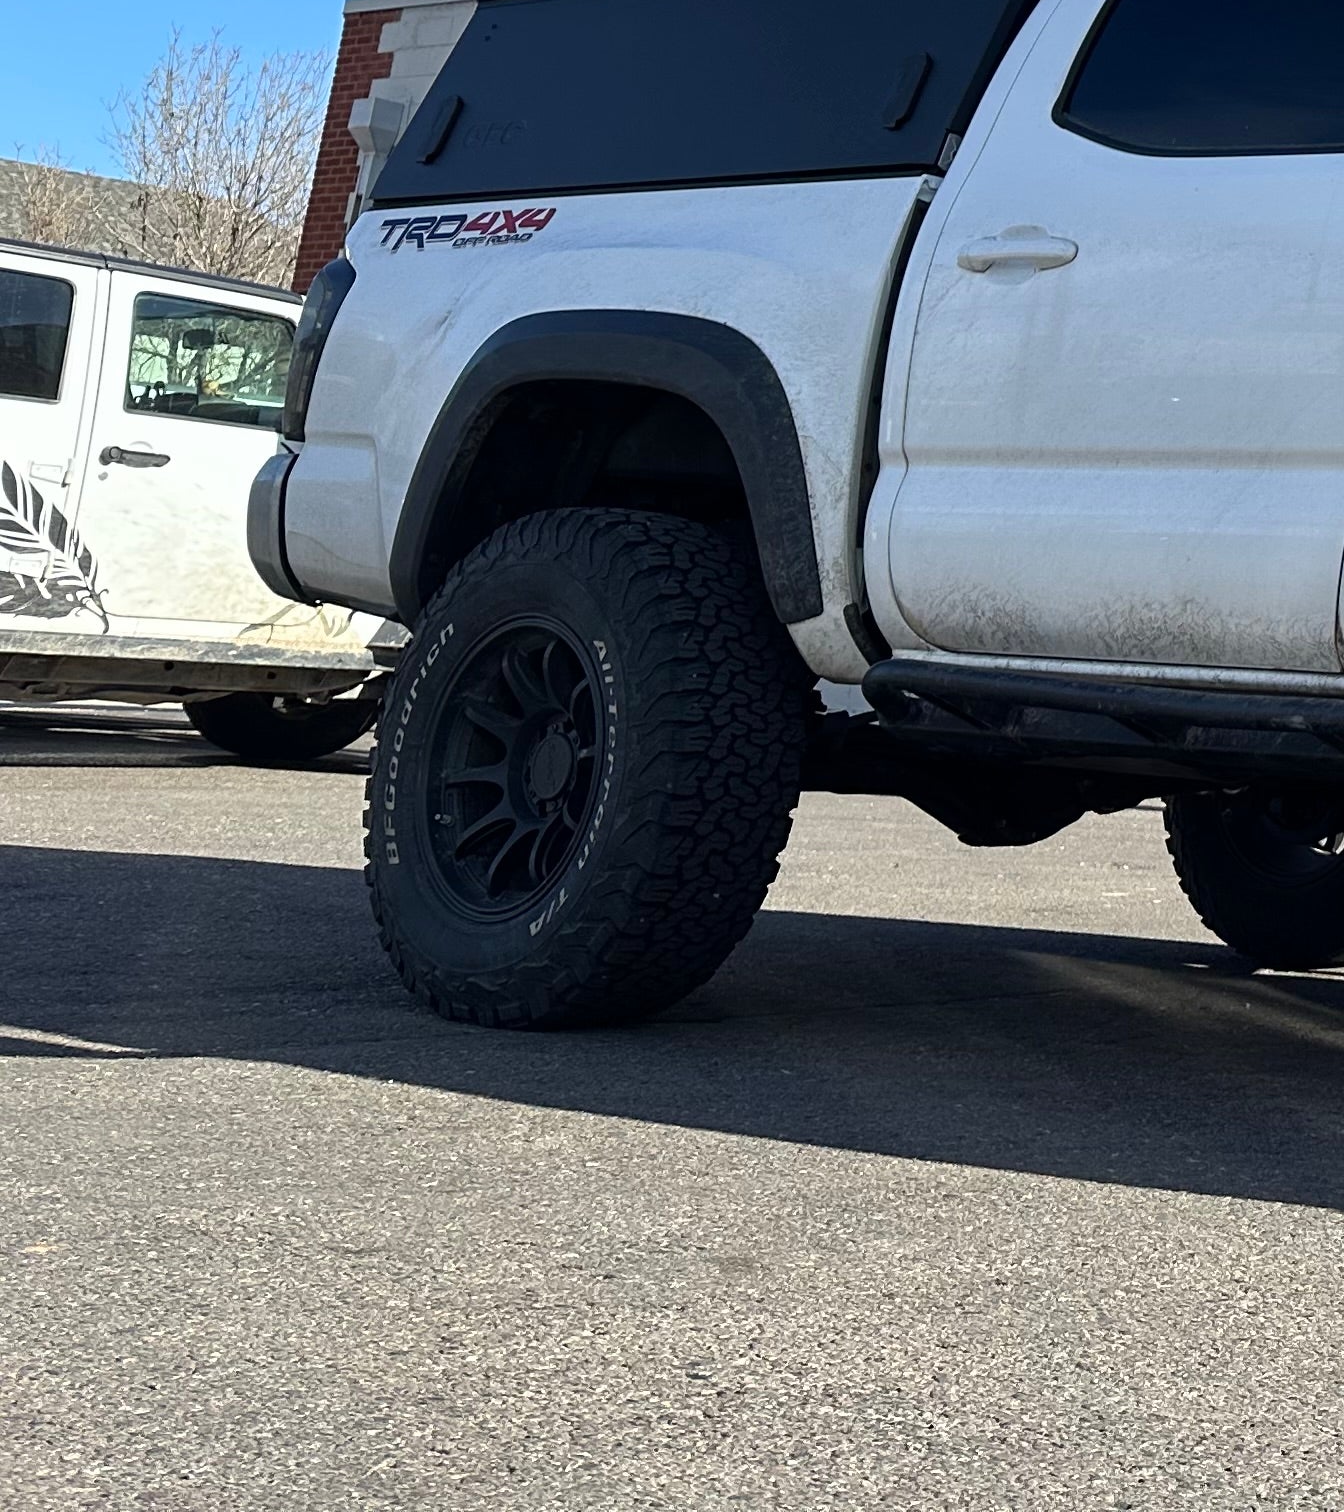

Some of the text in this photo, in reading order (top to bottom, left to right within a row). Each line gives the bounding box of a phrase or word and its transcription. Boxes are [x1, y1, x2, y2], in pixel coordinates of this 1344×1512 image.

[452, 235, 487, 249] OFF
[383, 621, 455, 865] BFGoodrich
[529, 887, 569, 937] T/A
